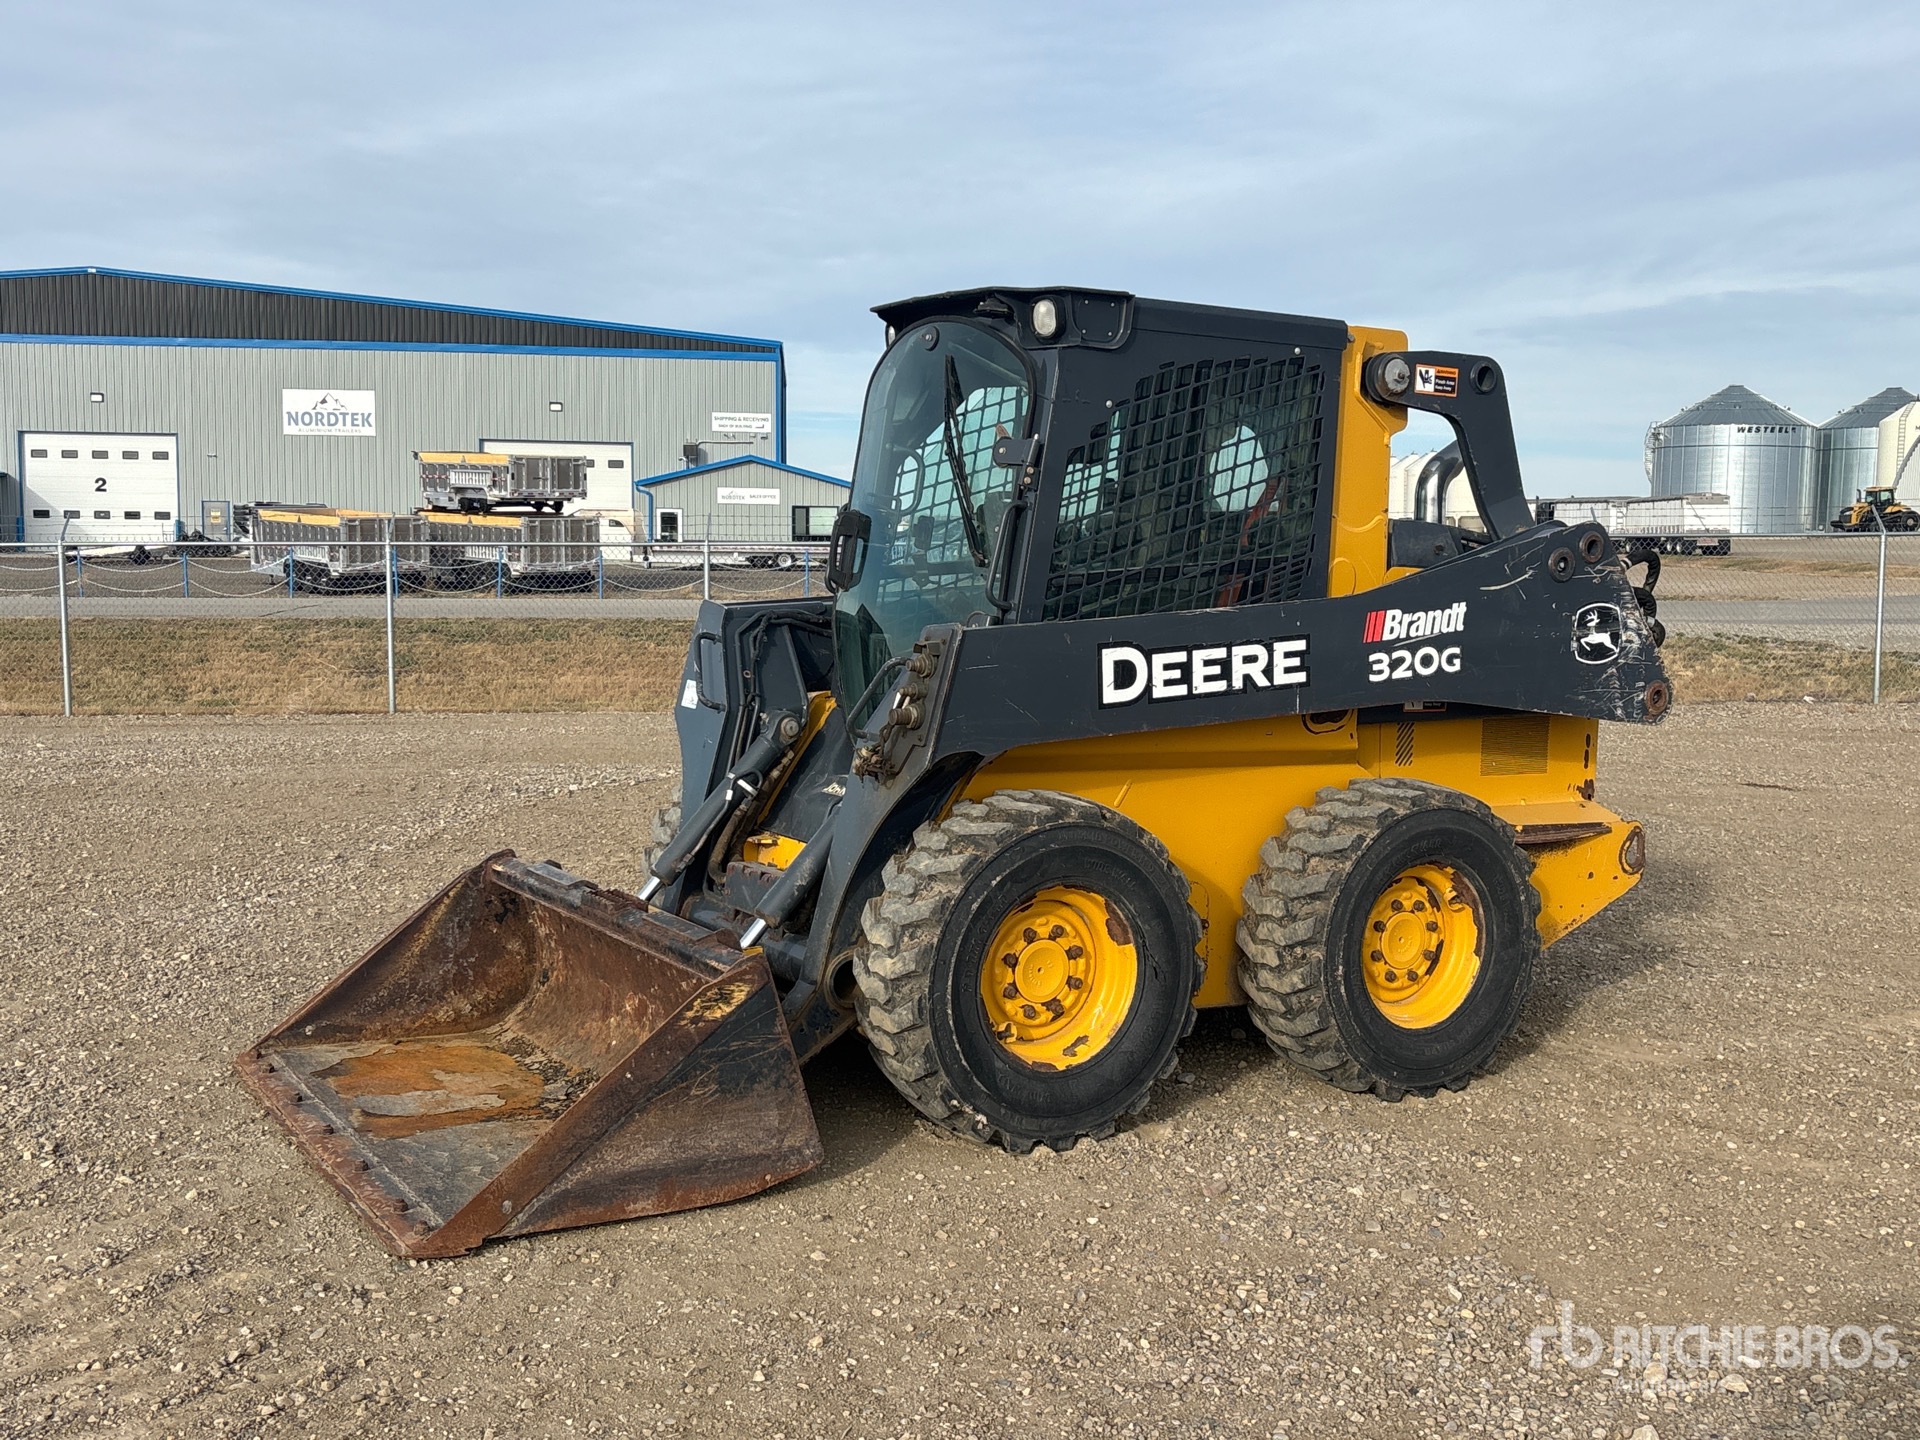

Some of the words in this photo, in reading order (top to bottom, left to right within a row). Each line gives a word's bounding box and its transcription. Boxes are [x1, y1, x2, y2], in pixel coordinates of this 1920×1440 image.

[286, 411, 373, 427] NORDTEK
[1737, 425, 1790, 434] WESTEEL
[95, 477, 107, 492] 2
[1383, 601, 1467, 638] Brandt
[1101, 639, 1307, 705] DEERE
[1368, 646, 1461, 682] 320G
